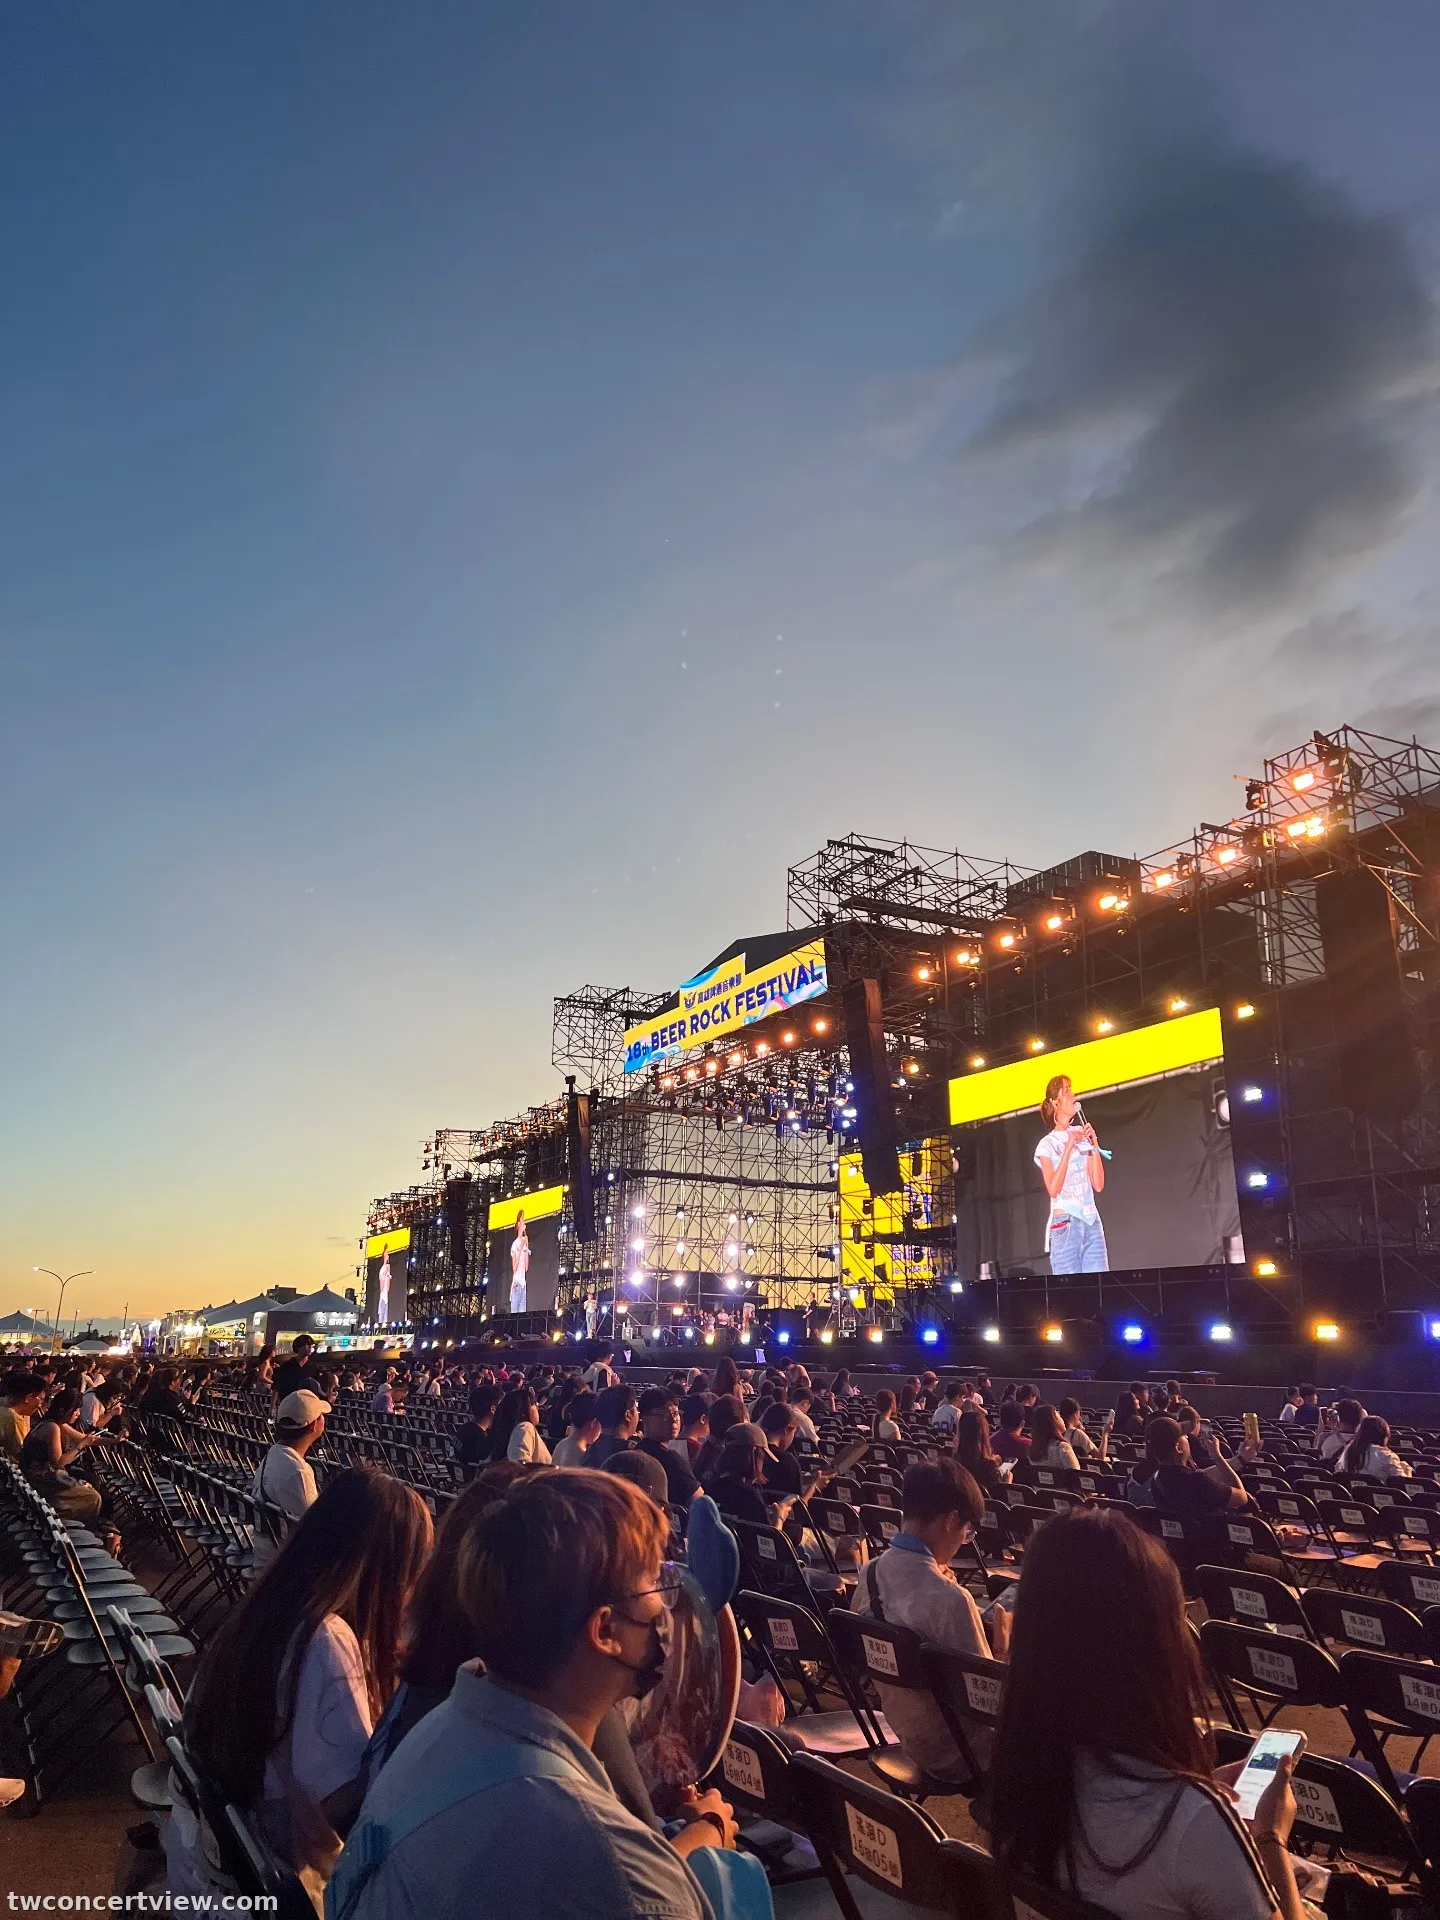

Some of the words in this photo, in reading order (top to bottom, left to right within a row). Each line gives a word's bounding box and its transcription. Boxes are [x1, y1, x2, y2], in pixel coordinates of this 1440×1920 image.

[627, 1040, 650, 1062] 18th
[650, 1018, 687, 1050] BEER
[689, 998, 732, 1036] ROCK
[735, 959, 824, 1015] FESTIVAL
